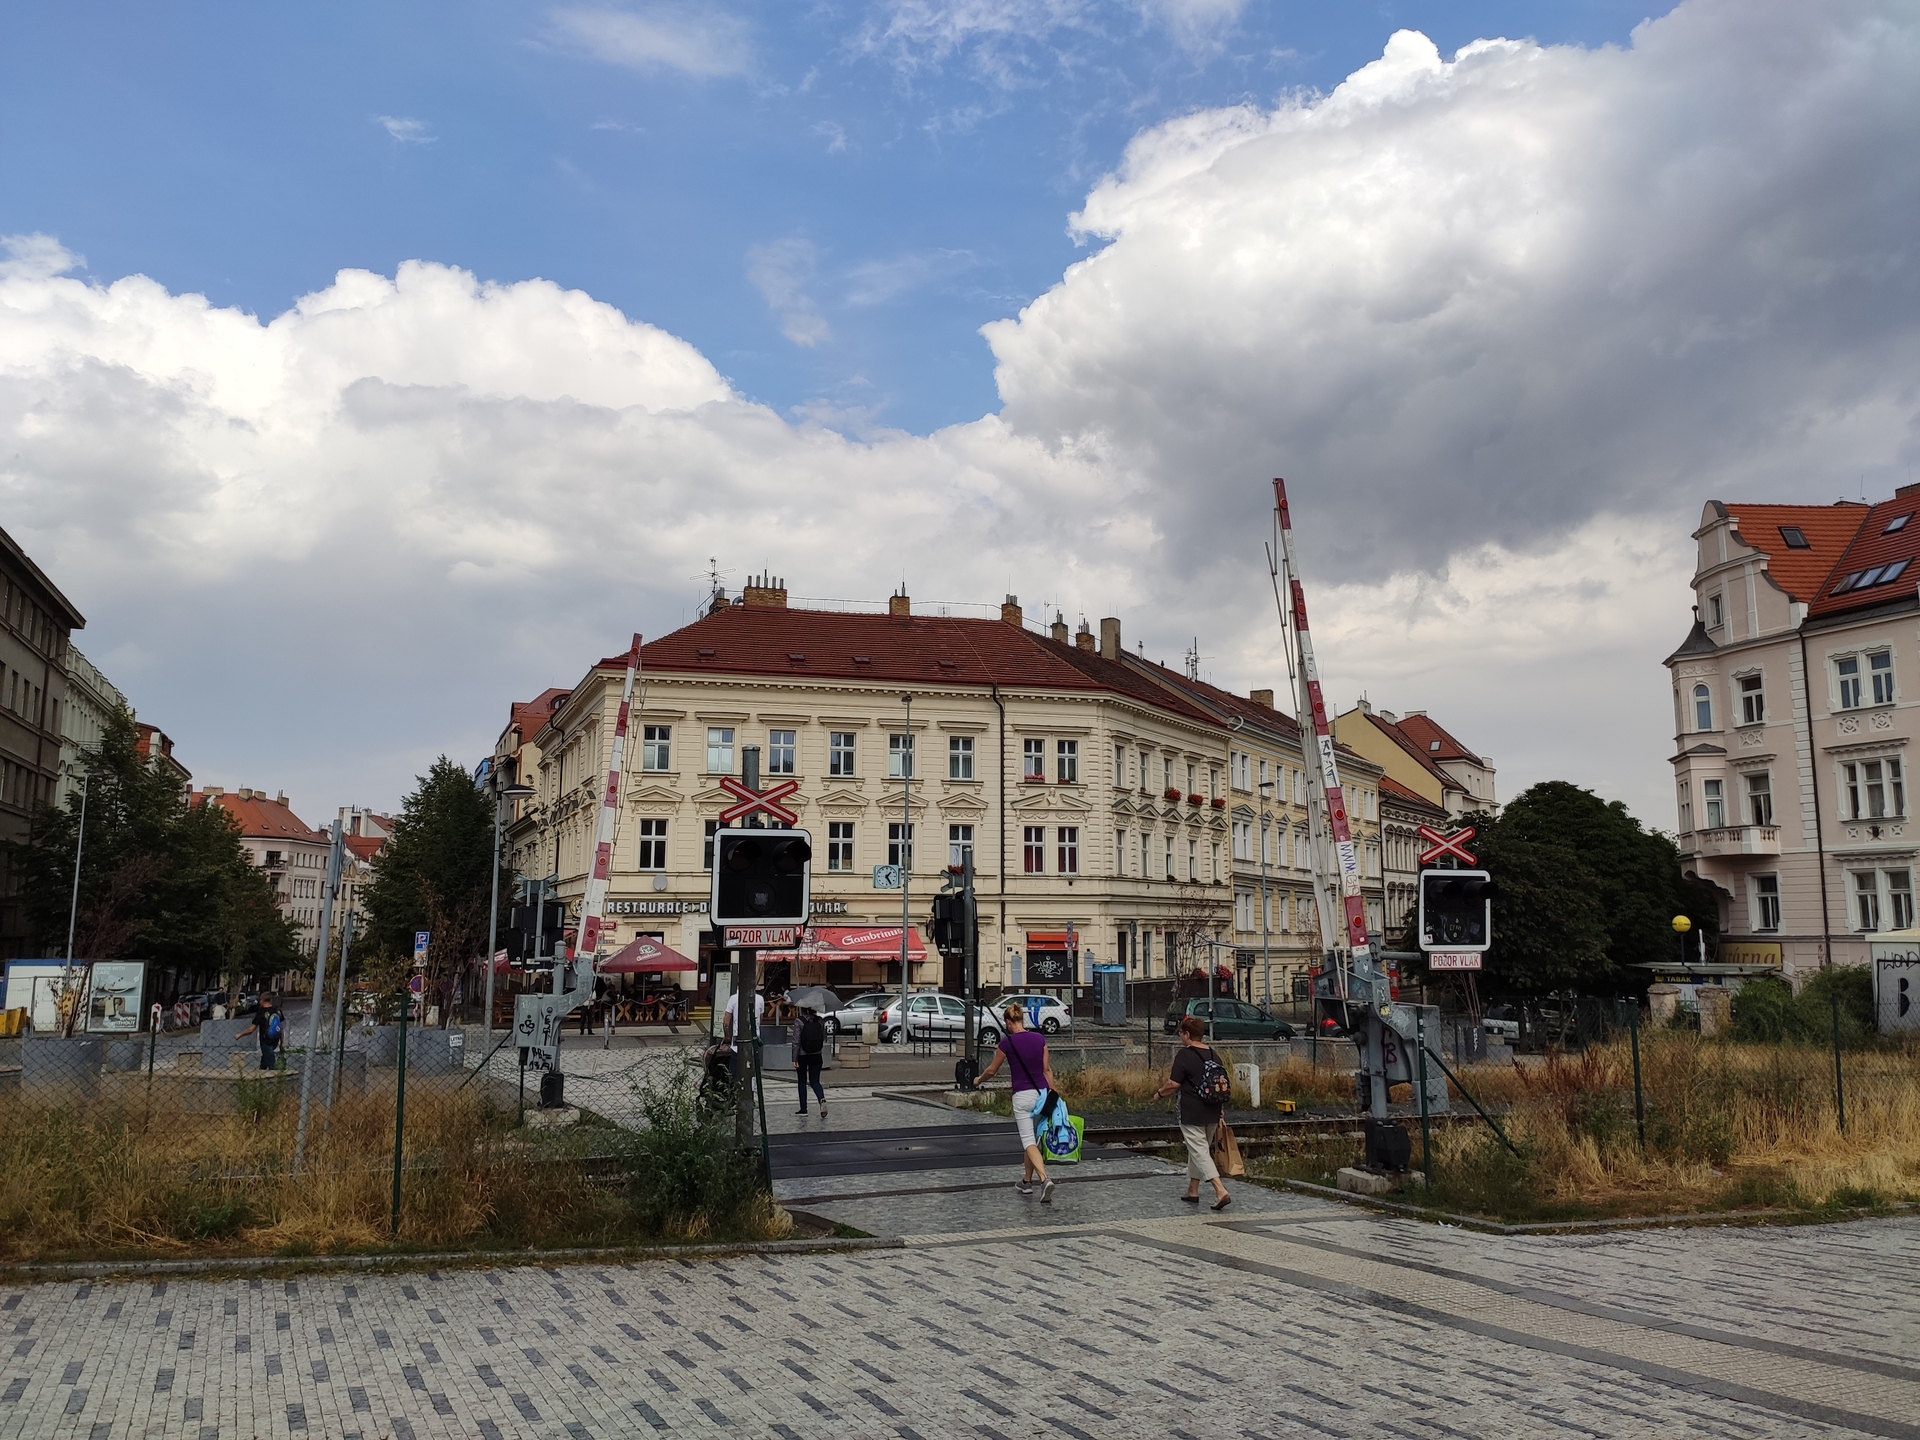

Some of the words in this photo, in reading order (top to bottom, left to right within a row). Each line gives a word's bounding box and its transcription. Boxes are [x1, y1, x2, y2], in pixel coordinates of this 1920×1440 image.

[607, 902, 688, 913] RESTAURACE
[809, 902, 841, 913] OVNA
[729, 929, 762, 943] POZOR
[765, 929, 792, 943] VLAK
[1433, 955, 1458, 967] POZOR
[1460, 955, 1480, 967] VLAK
